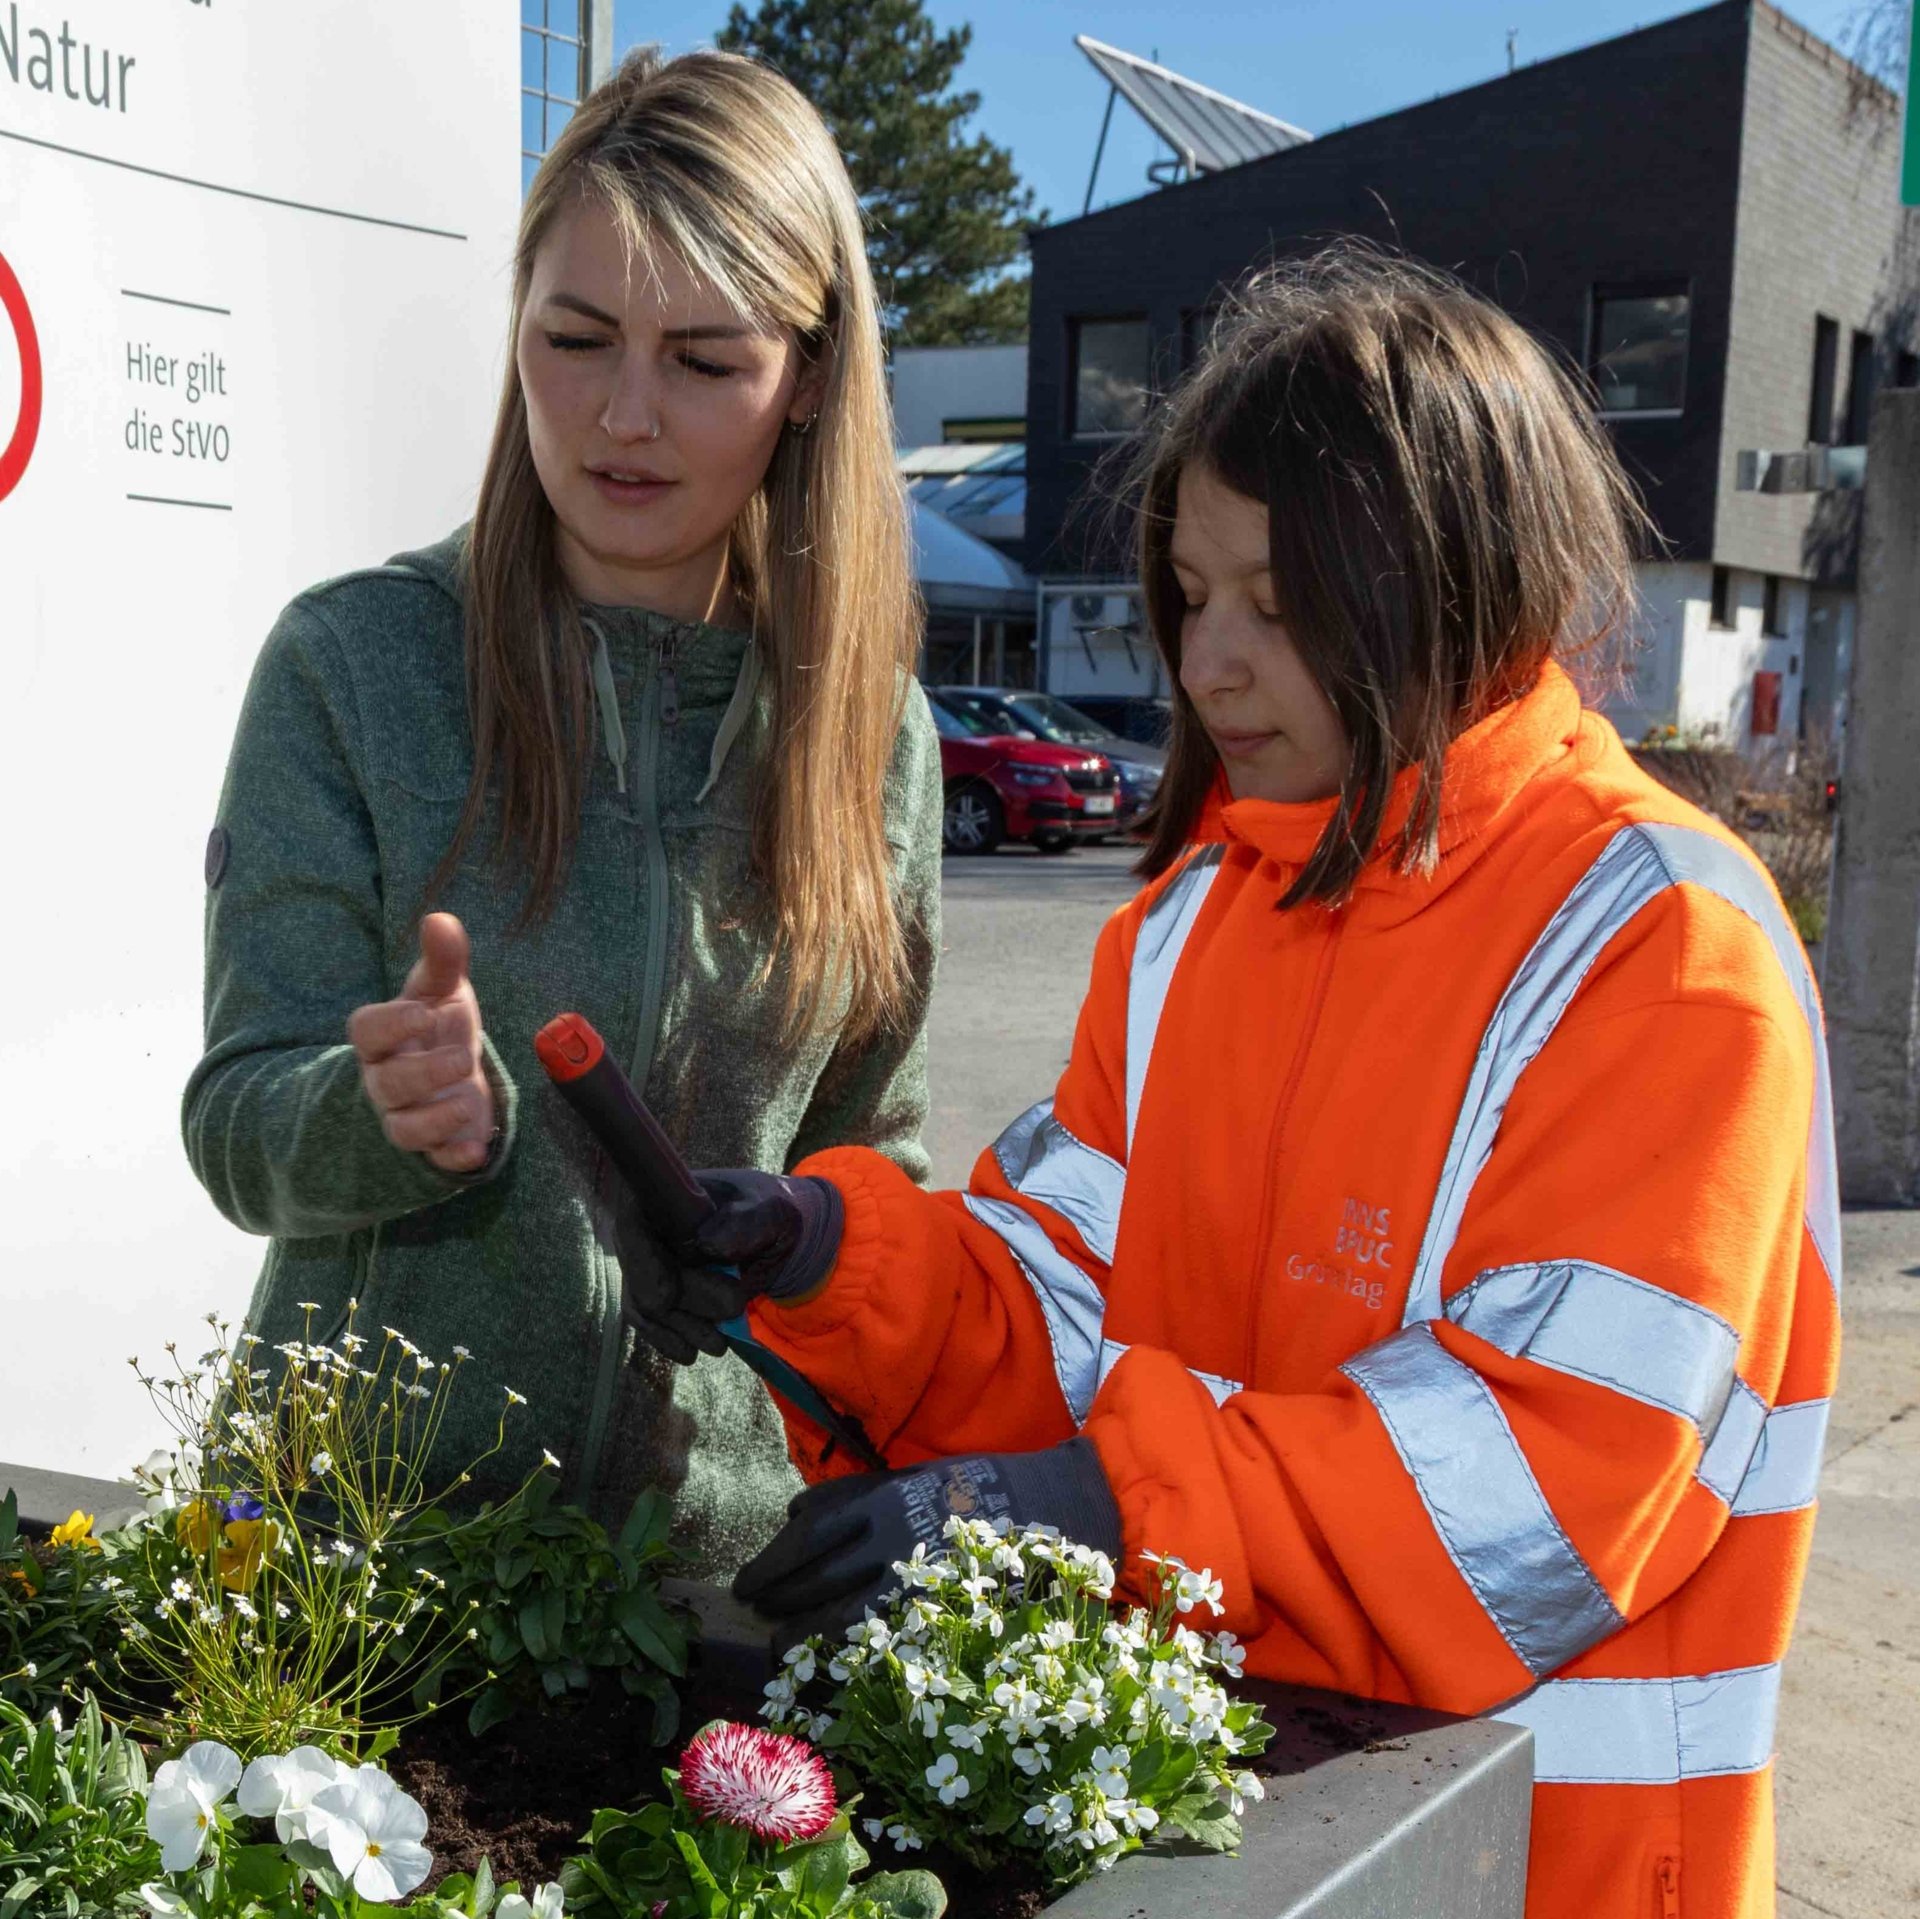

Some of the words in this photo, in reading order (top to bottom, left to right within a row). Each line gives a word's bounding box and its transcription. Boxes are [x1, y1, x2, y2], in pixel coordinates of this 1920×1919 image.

[0, 2, 136, 113] Natur
[127, 341, 179, 387] Hier
[186, 351, 227, 403] gilt
[125, 407, 163, 454] die
[172, 419, 230, 462] StVO
